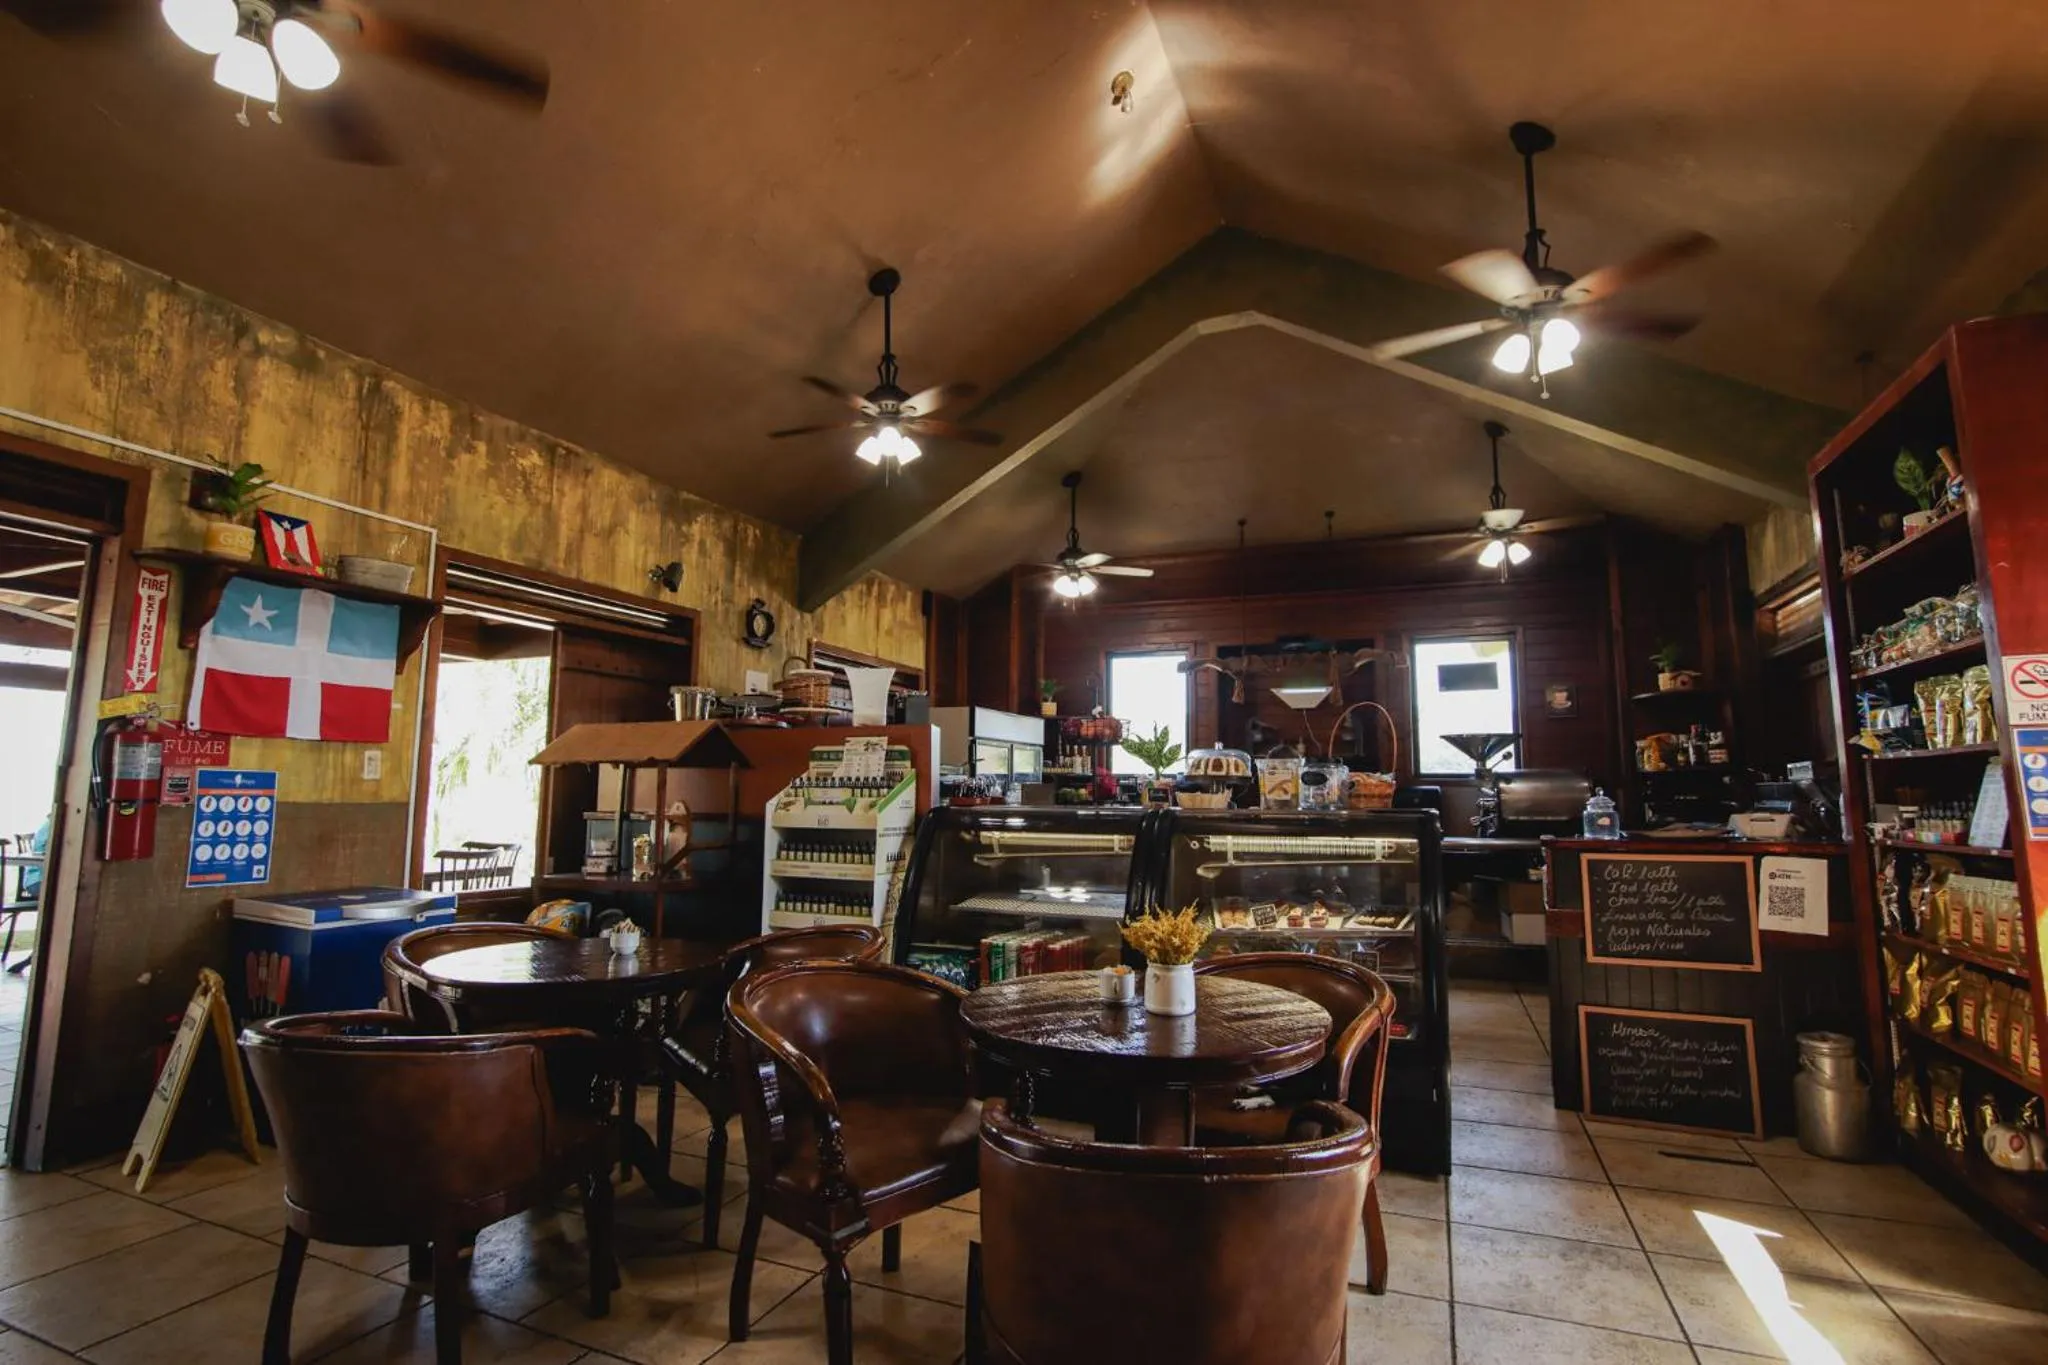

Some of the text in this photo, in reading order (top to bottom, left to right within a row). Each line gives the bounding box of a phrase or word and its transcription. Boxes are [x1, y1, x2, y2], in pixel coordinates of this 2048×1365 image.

[141, 577, 167, 592] FIRE
[136, 595, 156, 685] EXTINGUISHER
[163, 739, 225, 754] FUME
